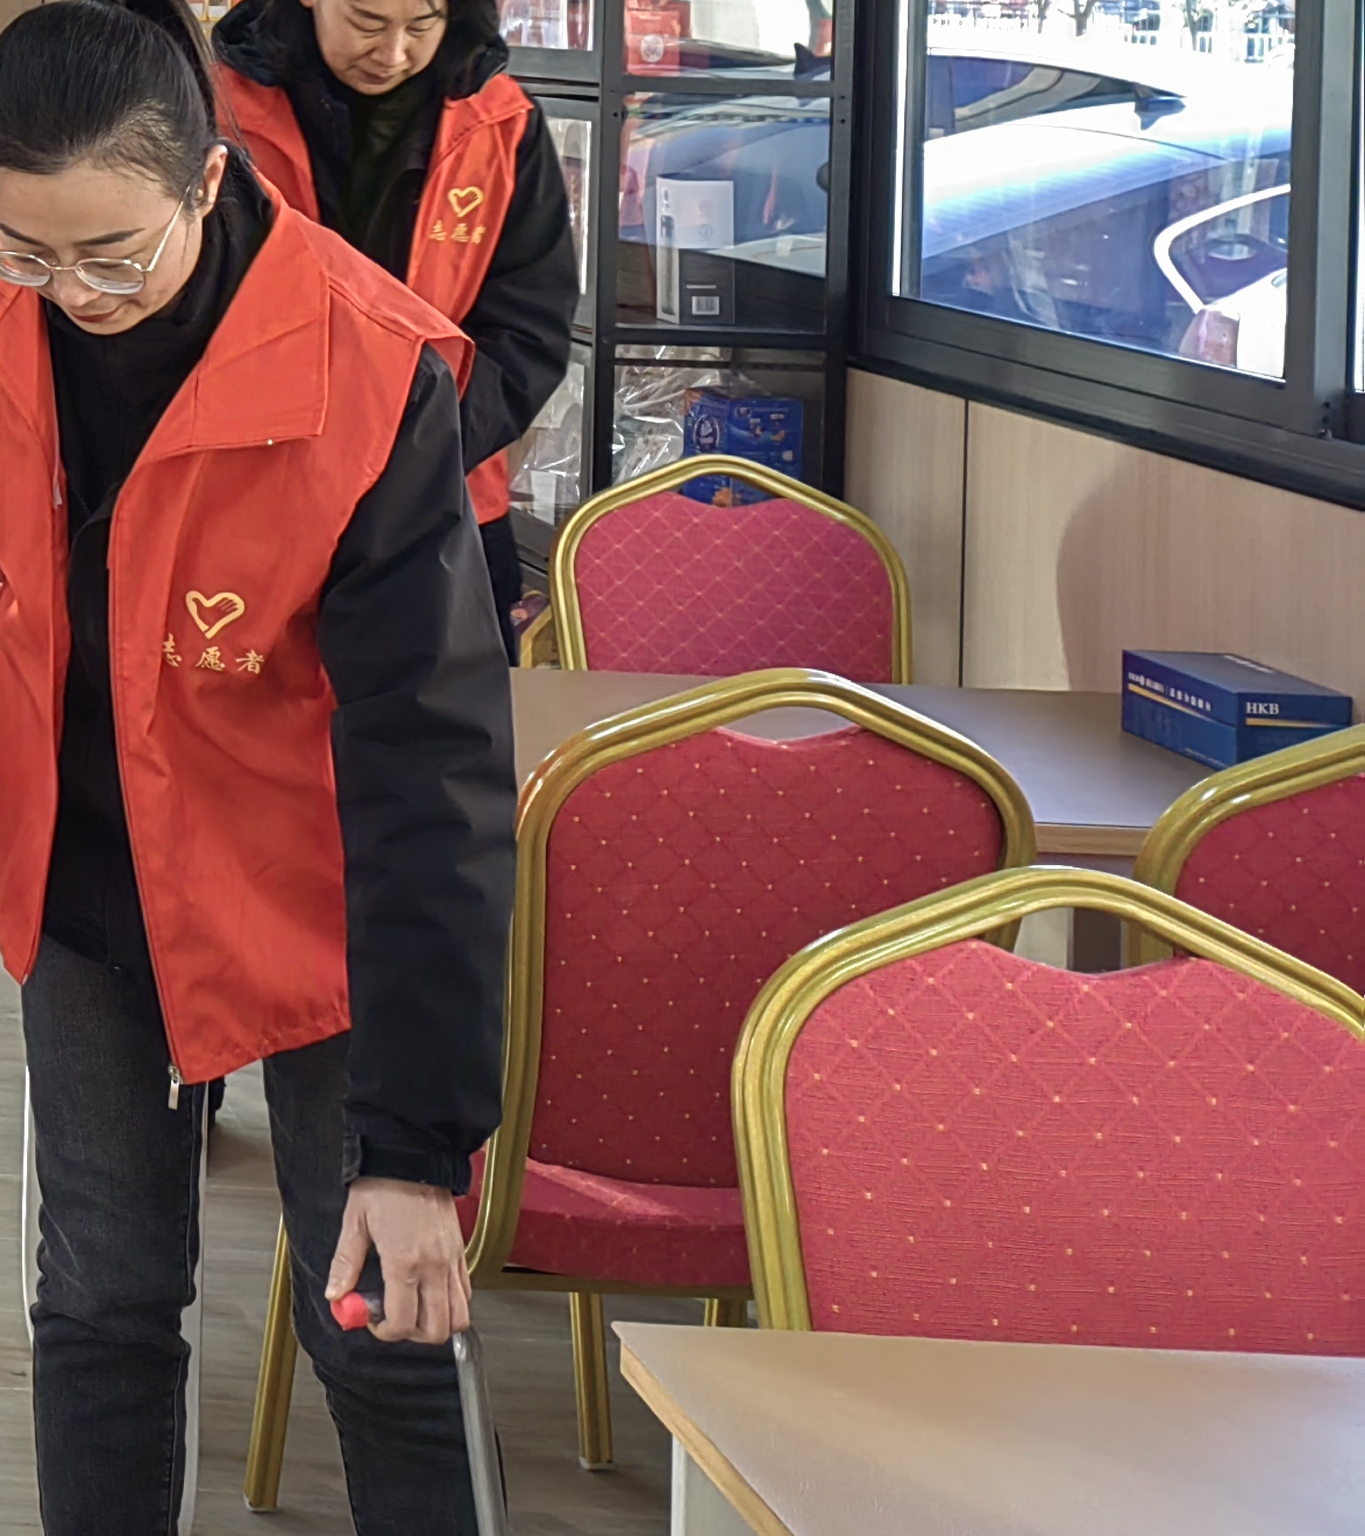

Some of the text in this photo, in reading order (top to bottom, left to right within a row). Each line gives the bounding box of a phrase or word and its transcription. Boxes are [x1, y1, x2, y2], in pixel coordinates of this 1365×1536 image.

[161, 632, 265, 674] 志愿者
[1245, 701, 1280, 715] HKB
